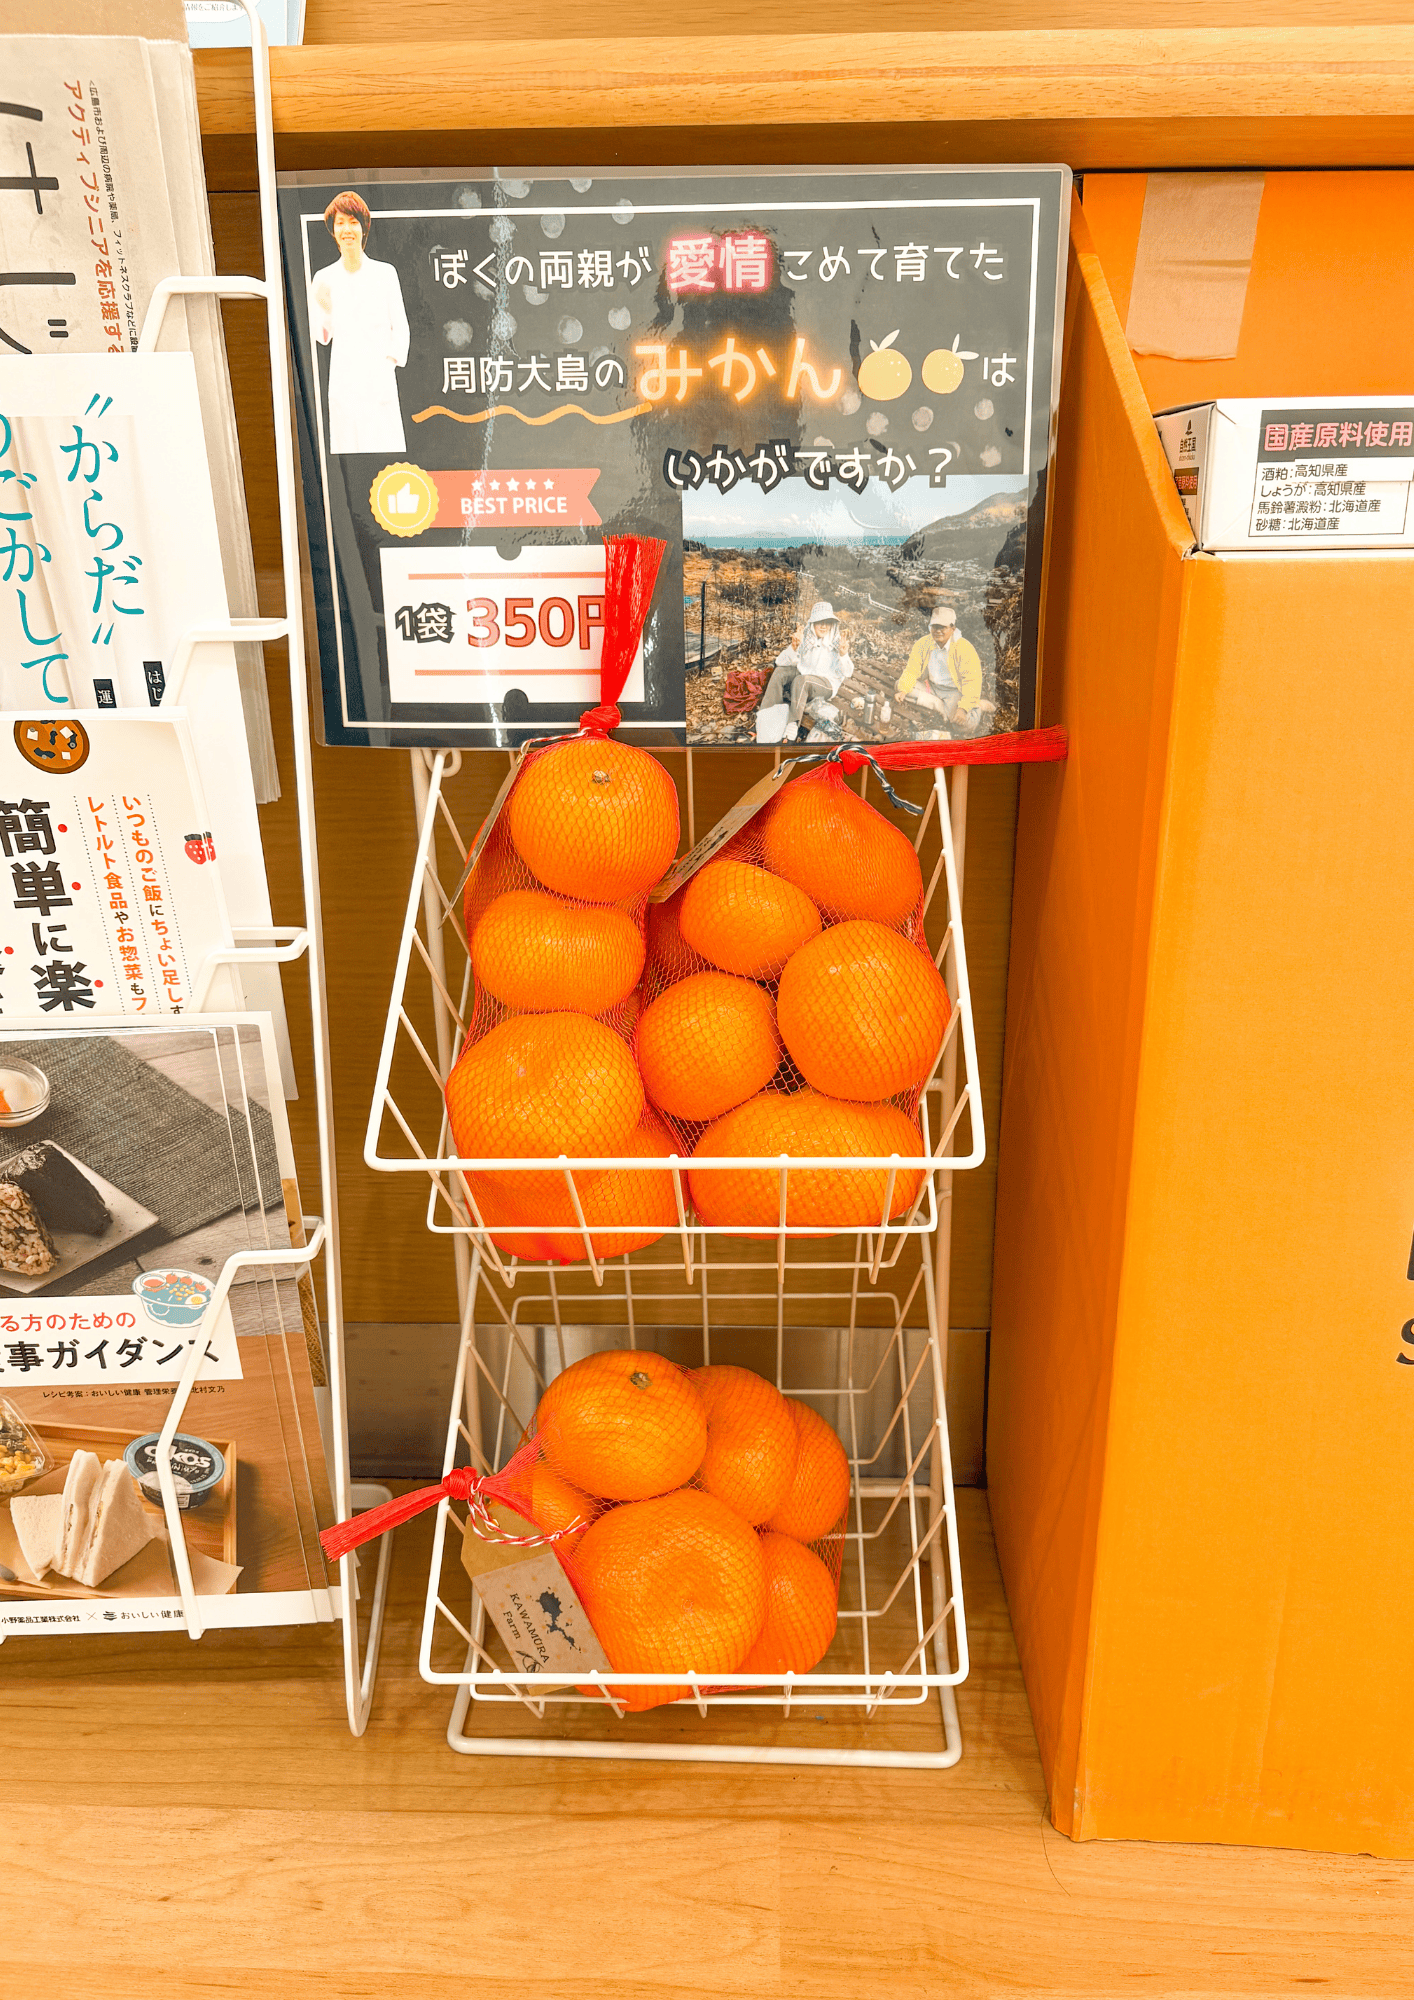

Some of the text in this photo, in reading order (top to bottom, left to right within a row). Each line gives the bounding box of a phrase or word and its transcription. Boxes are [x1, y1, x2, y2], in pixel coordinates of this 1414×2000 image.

[433, 235, 1004, 289] ぼくの両親が 愛情 こめて育てた
[441, 353, 624, 394] 周防大島の
[635, 337, 842, 401] みかん
[1264, 420, 1413, 451] 国産原料使用
[667, 444, 953, 488] いかがですか？
[460, 496, 568, 515] BEST PRICE
[396, 604, 454, 642] 1袋
[502, 1610, 521, 1640] Farm
[509, 1592, 550, 1664] KAWAMURA
